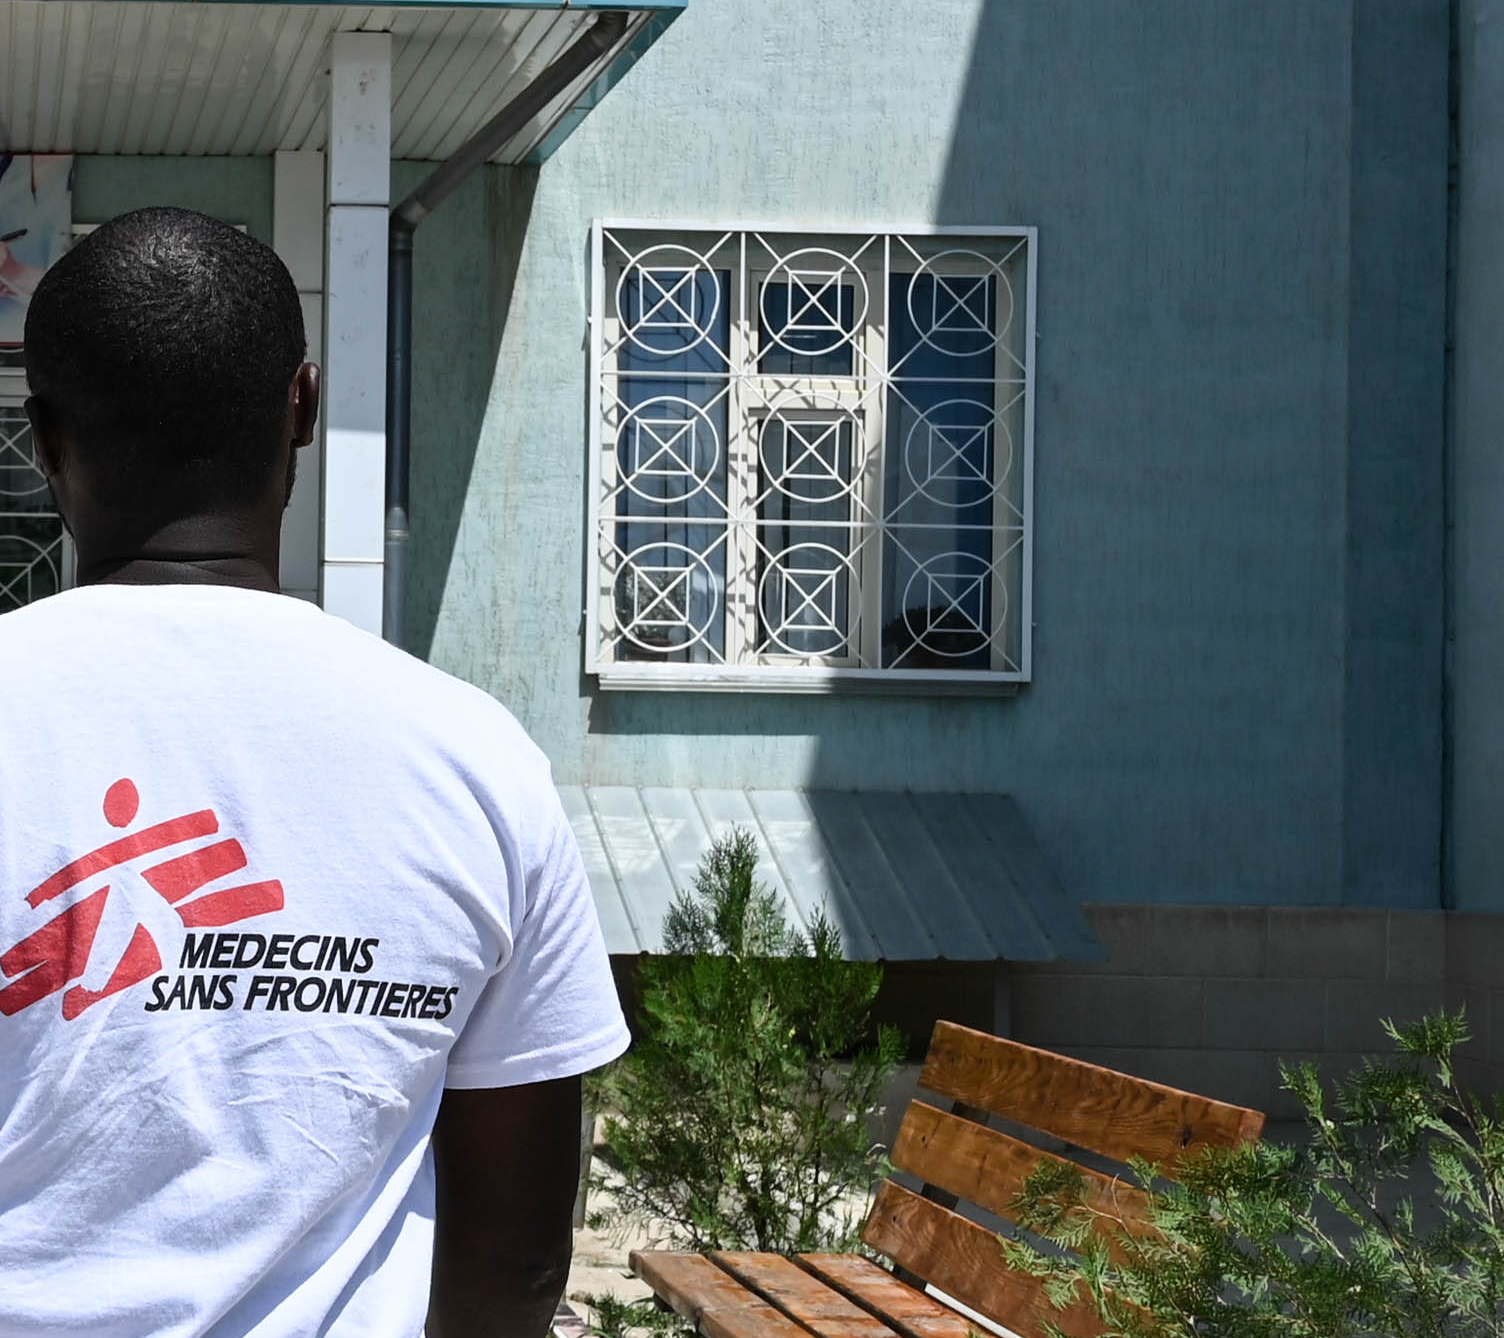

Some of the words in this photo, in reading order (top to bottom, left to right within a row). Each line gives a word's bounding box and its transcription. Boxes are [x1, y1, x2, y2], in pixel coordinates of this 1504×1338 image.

[178, 932, 380, 975] MEDECINS
[143, 973, 239, 1013] SANS
[242, 974, 460, 1021] FRONTIERES
